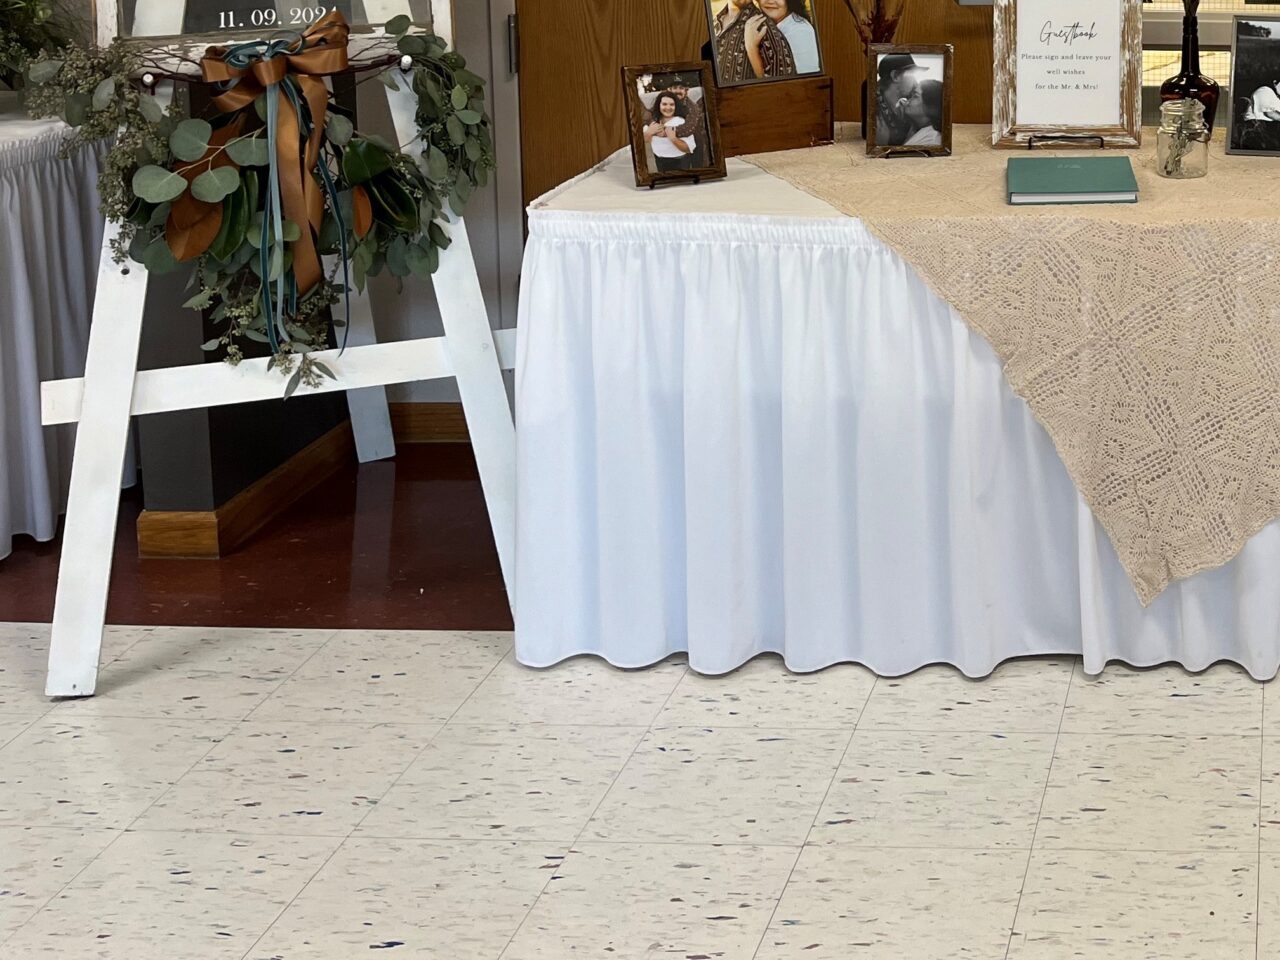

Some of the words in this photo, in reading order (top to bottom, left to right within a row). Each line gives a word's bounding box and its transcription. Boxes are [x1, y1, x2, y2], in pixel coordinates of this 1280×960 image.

[250, 8, 282, 26] 09.
[289, 5, 337, 25] 202
[1040, 20, 1098, 46] Guestbook
